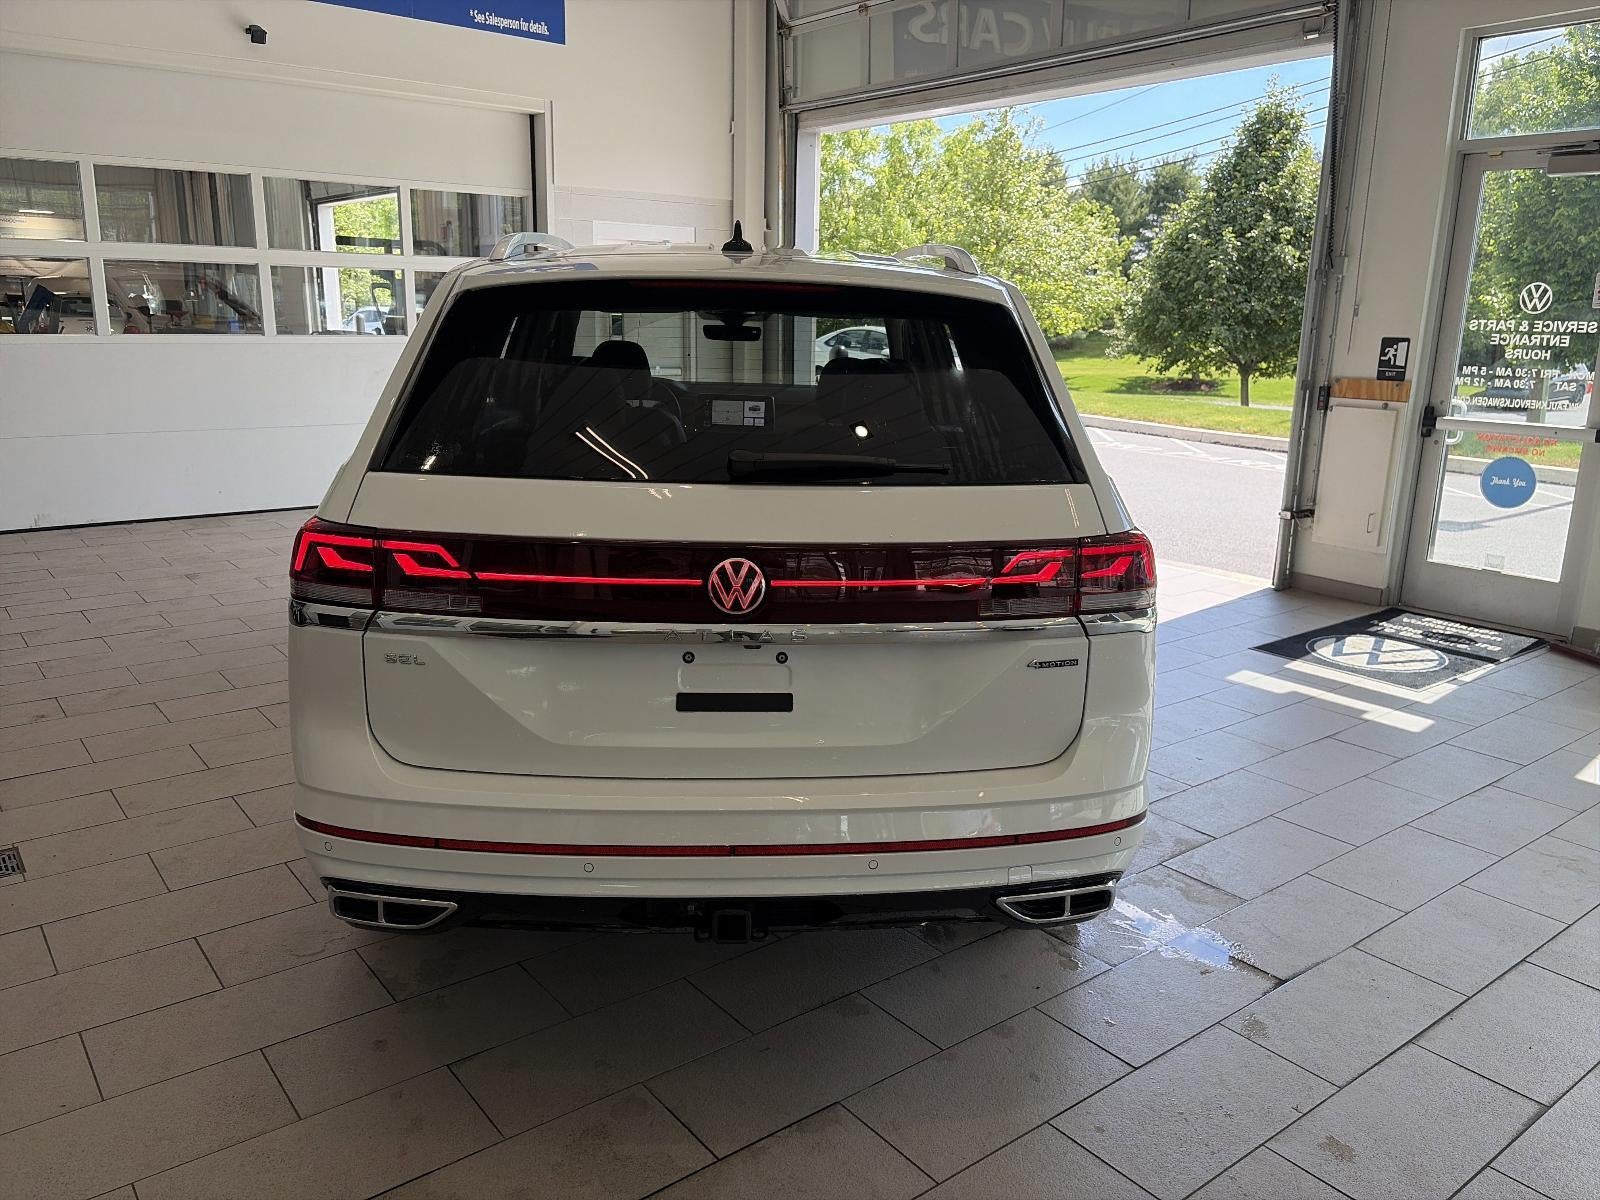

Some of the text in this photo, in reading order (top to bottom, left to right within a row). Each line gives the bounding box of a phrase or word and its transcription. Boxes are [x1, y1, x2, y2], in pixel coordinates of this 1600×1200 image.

[485, 12, 520, 29] Salesperson
[520, 18, 529, 31] for
[529, 20, 550, 35] details.
[1490, 476, 1527, 488] Thank You
[664, 628, 808, 642] ATLAS
[384, 652, 426, 666] SEL
[1027, 658, 1078, 669] 4MOTION
